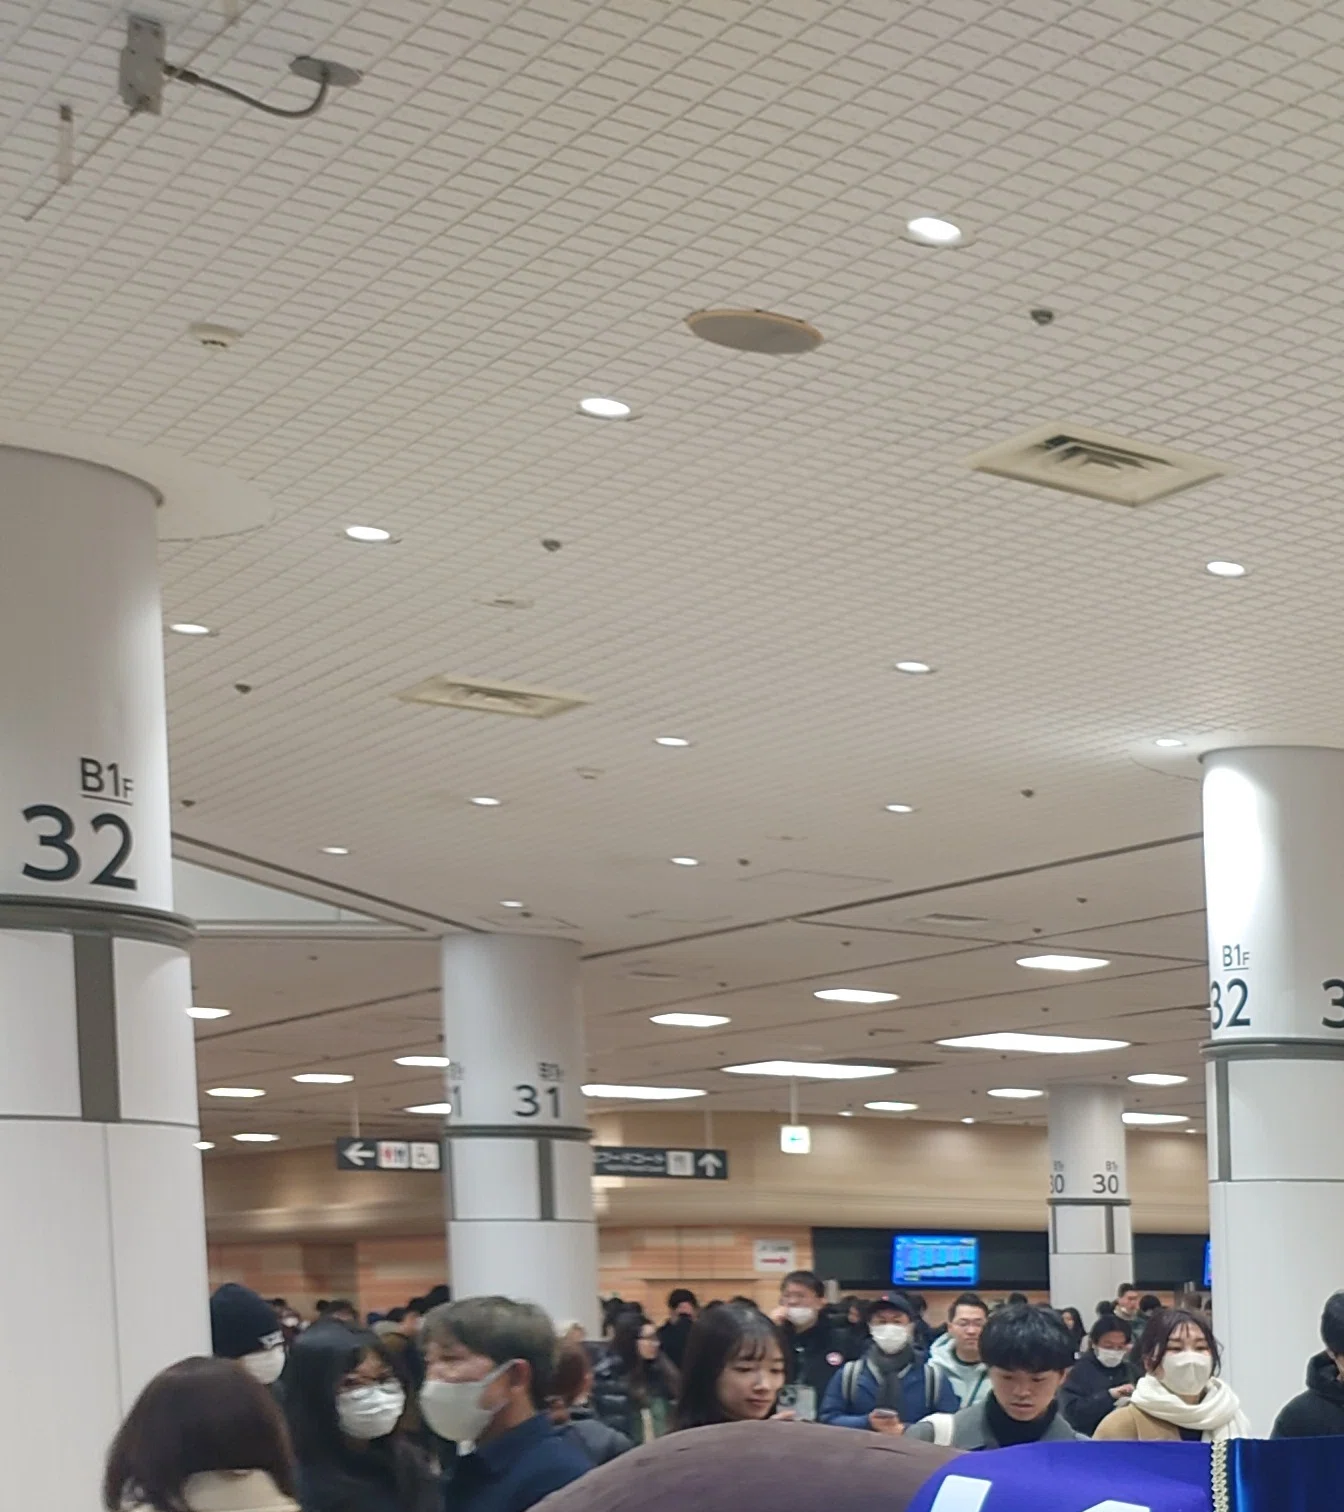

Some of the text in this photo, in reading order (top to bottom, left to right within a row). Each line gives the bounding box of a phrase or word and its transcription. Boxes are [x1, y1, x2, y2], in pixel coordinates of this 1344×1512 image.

[80, 757, 134, 798] B1F
[22, 804, 137, 890] 32
[1222, 944, 1250, 968] B1F
[515, 1084, 559, 1118] 31
[1092, 1173, 1119, 1194] 30
